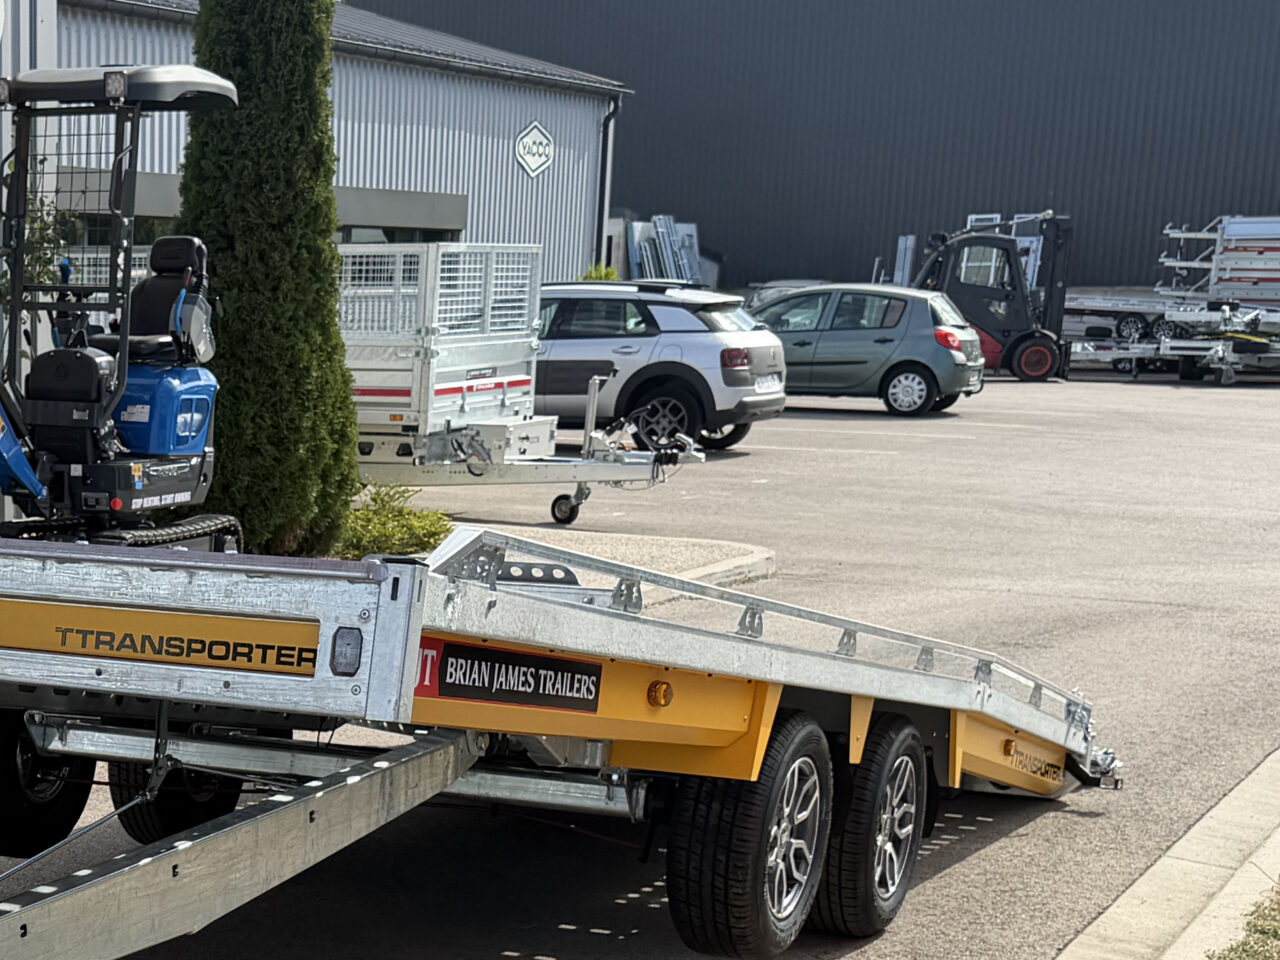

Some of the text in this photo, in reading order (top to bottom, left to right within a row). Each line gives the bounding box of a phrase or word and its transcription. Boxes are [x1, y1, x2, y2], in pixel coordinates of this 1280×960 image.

[521, 140, 550, 158] YACCO
[445, 657, 491, 688] BRIAN
[491, 662, 535, 693] JAMES
[538, 669, 597, 700] TRAILERS
